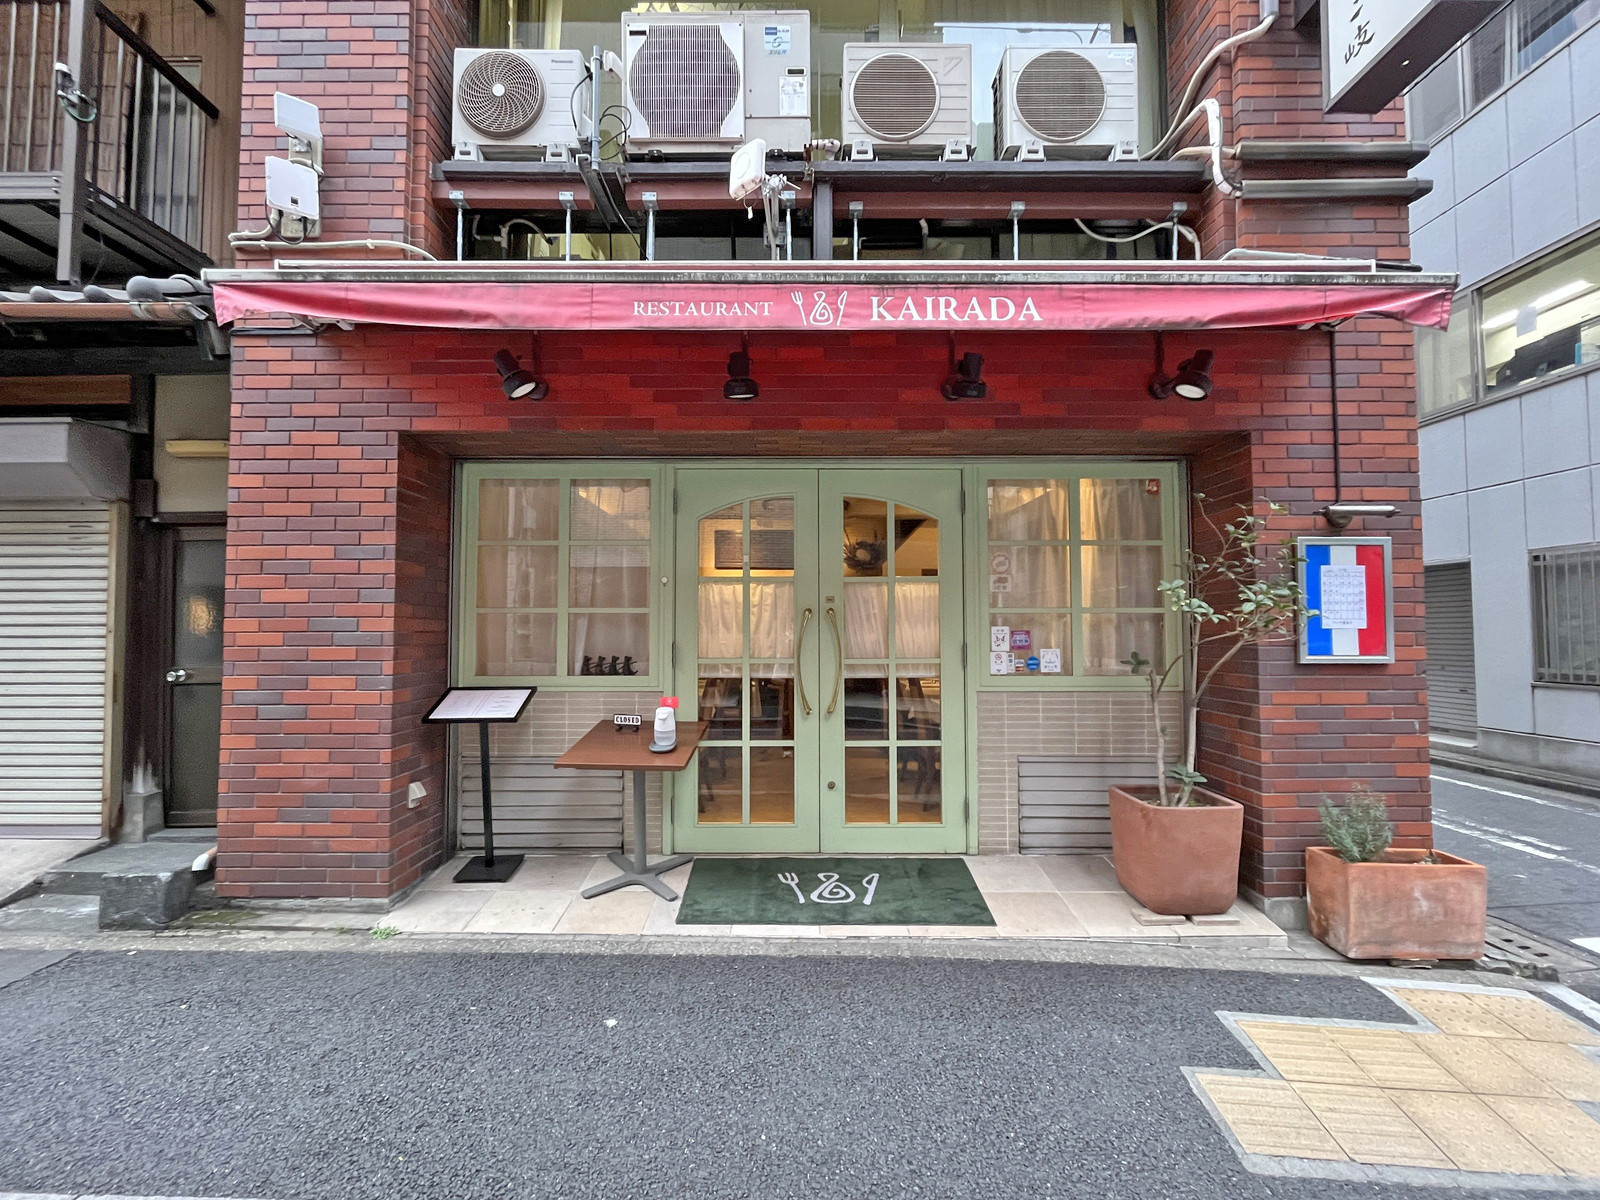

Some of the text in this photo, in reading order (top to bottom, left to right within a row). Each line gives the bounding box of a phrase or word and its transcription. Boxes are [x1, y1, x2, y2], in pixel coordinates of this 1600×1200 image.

[632, 296, 1044, 322] RESTAURANT KAIRADA
[615, 716, 640, 724] CLOSED
